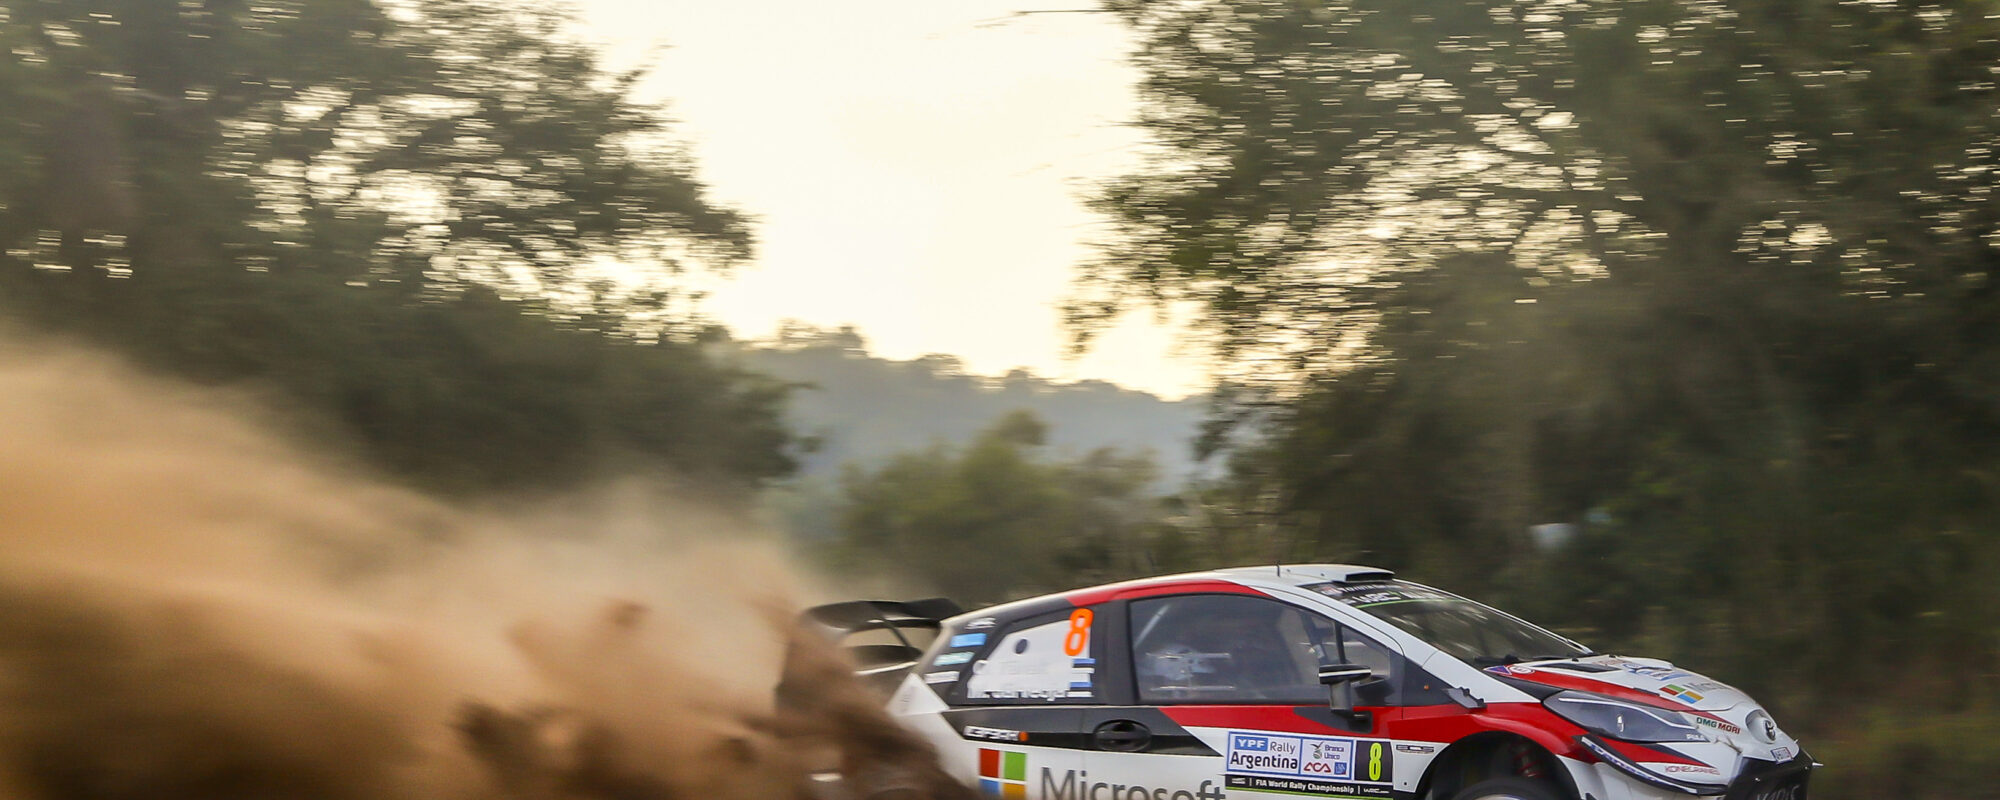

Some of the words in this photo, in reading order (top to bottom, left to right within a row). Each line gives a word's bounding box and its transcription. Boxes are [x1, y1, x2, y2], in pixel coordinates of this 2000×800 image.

[1064, 607, 1094, 656] 8
[1696, 717, 1717, 728] DMG
[1718, 723, 1741, 735] MORI
[1237, 739, 1266, 749] YPF
[1270, 741, 1296, 754] Rally
[1230, 751, 1298, 769] Argentina
[1304, 762, 1331, 773] ACA
[1369, 742, 1382, 781] 8
[1255, 779, 1267, 787] FIA
[1268, 780, 1288, 789] World
[1290, 782, 1306, 791] Rally
[1308, 783, 1354, 794] Championship
